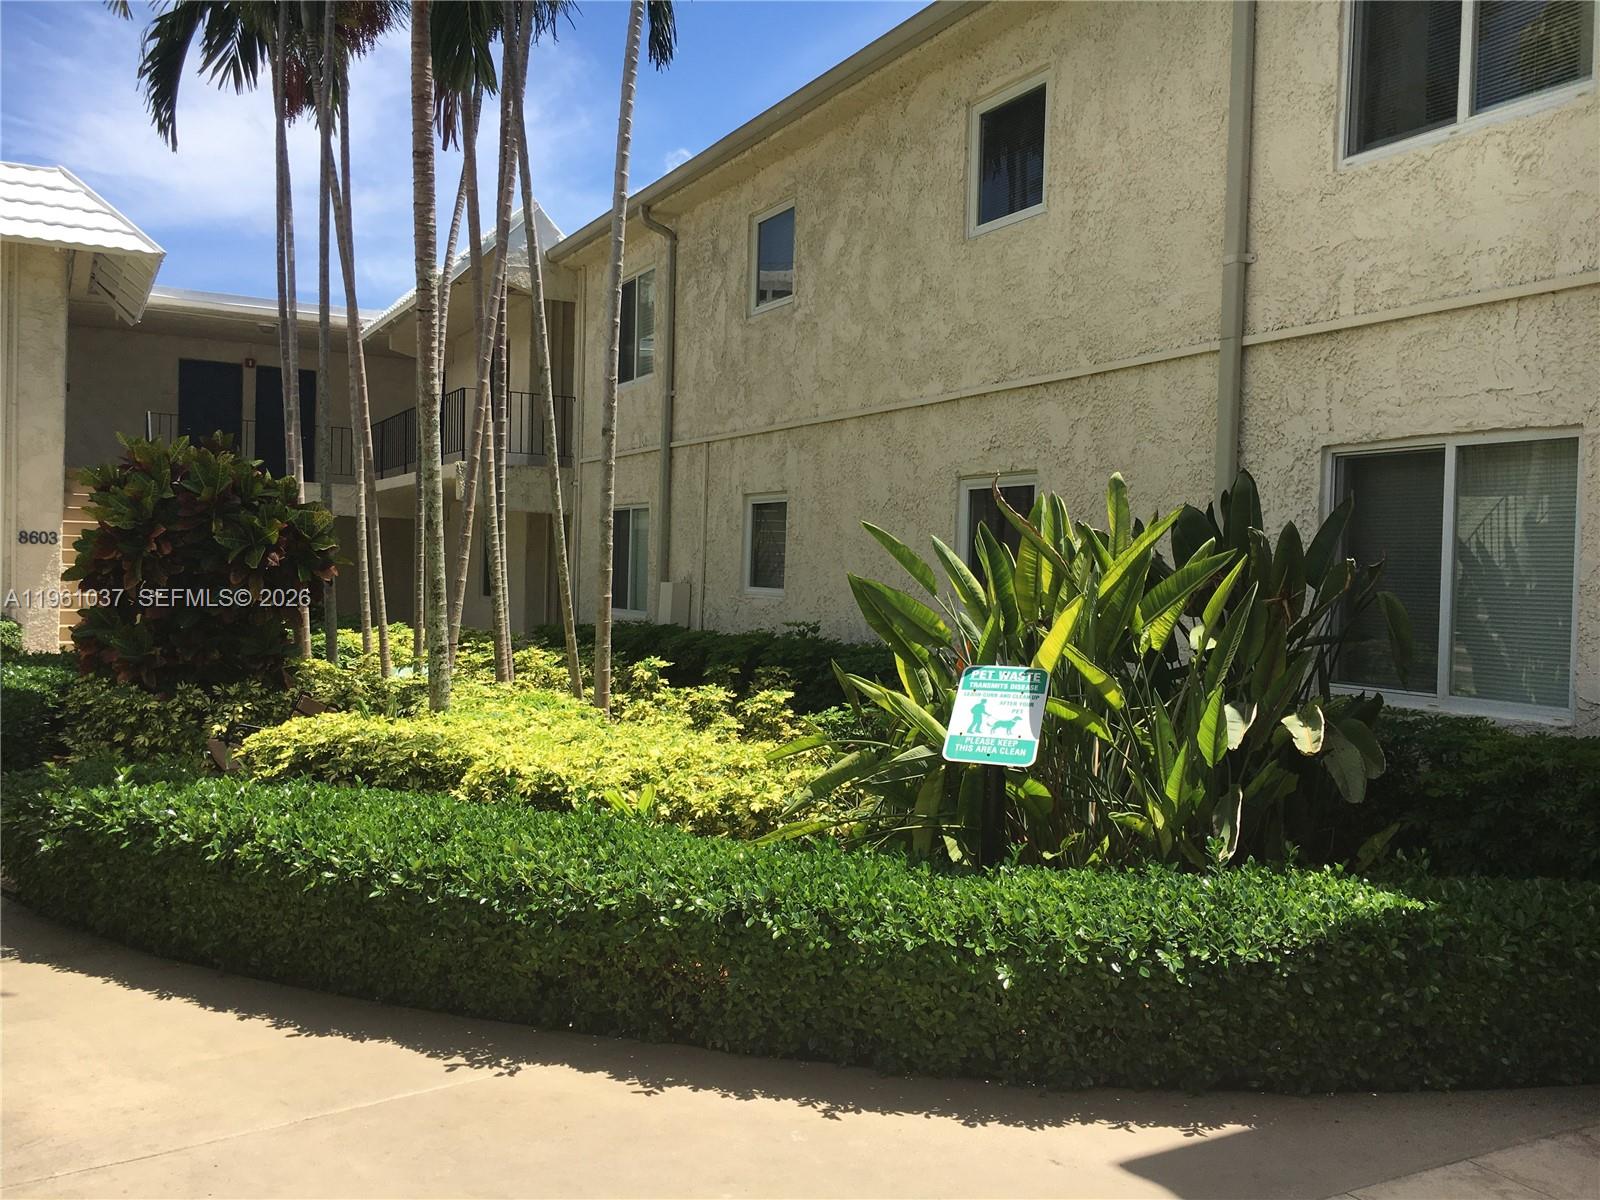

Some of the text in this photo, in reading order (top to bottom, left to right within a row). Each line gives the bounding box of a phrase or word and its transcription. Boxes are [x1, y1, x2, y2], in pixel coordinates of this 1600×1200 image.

[18, 530, 58, 545] 8603
[970, 670, 1041, 683] PET WASTE
[969, 682, 1009, 690] TRANSMITS
[964, 737, 1019, 747] PLEASE KEEP
[955, 743, 1026, 756] THIS AREA CLEAN
